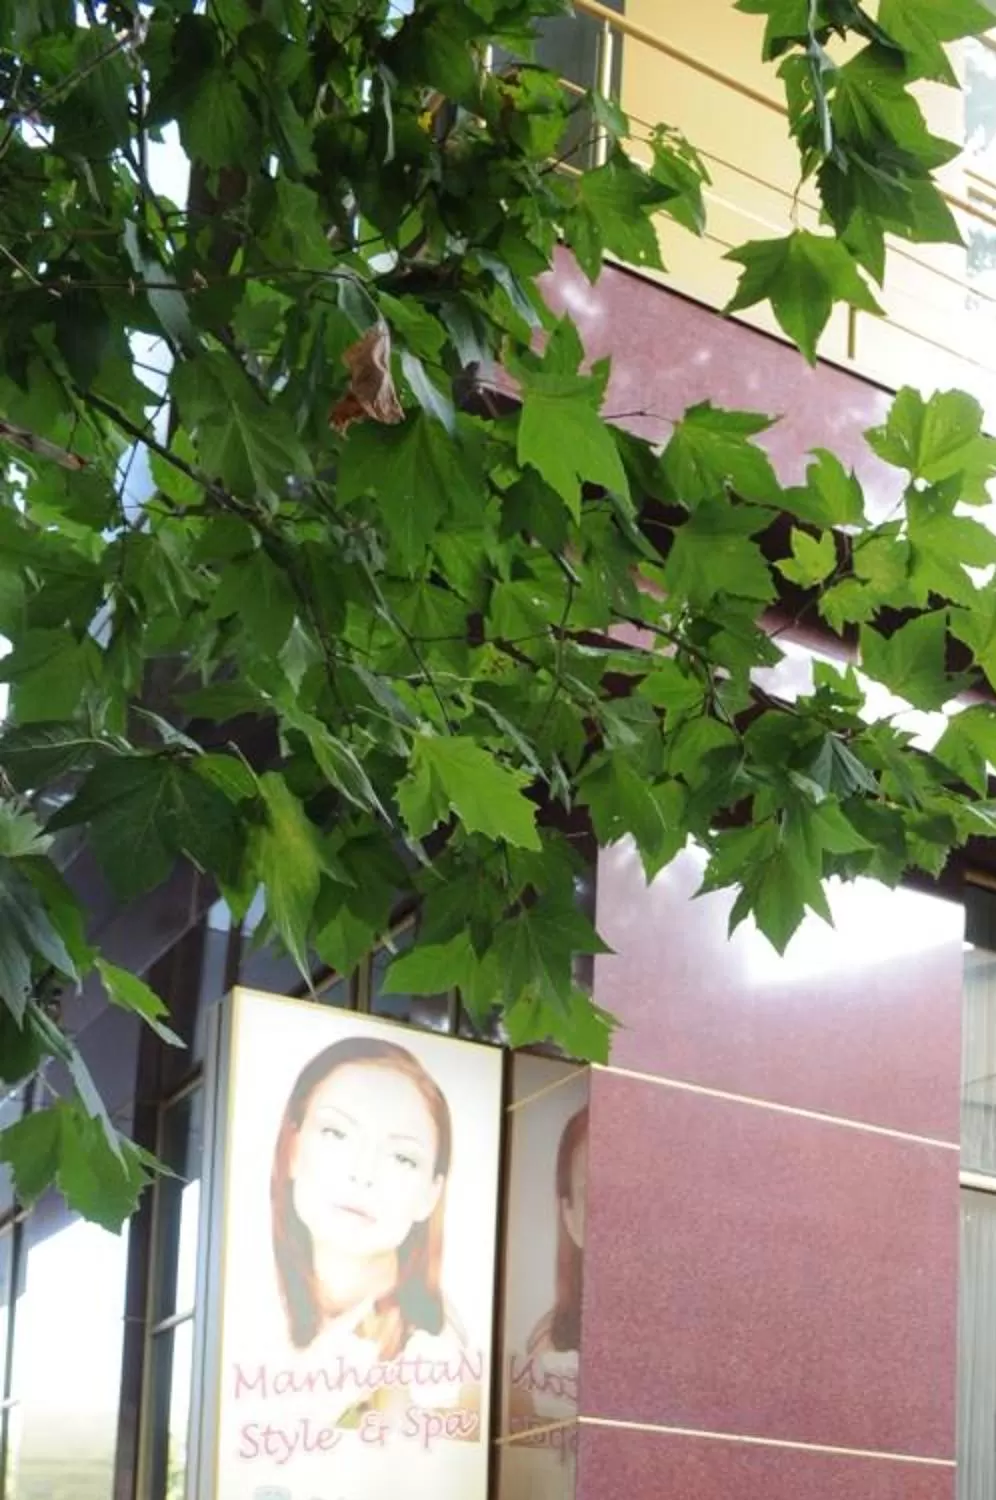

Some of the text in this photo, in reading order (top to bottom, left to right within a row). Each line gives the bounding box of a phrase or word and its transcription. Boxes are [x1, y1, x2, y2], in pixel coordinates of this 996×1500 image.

[238, 1418, 342, 1465] Style
[359, 1411, 391, 1447] &
[402, 1404, 479, 1451] Spa
